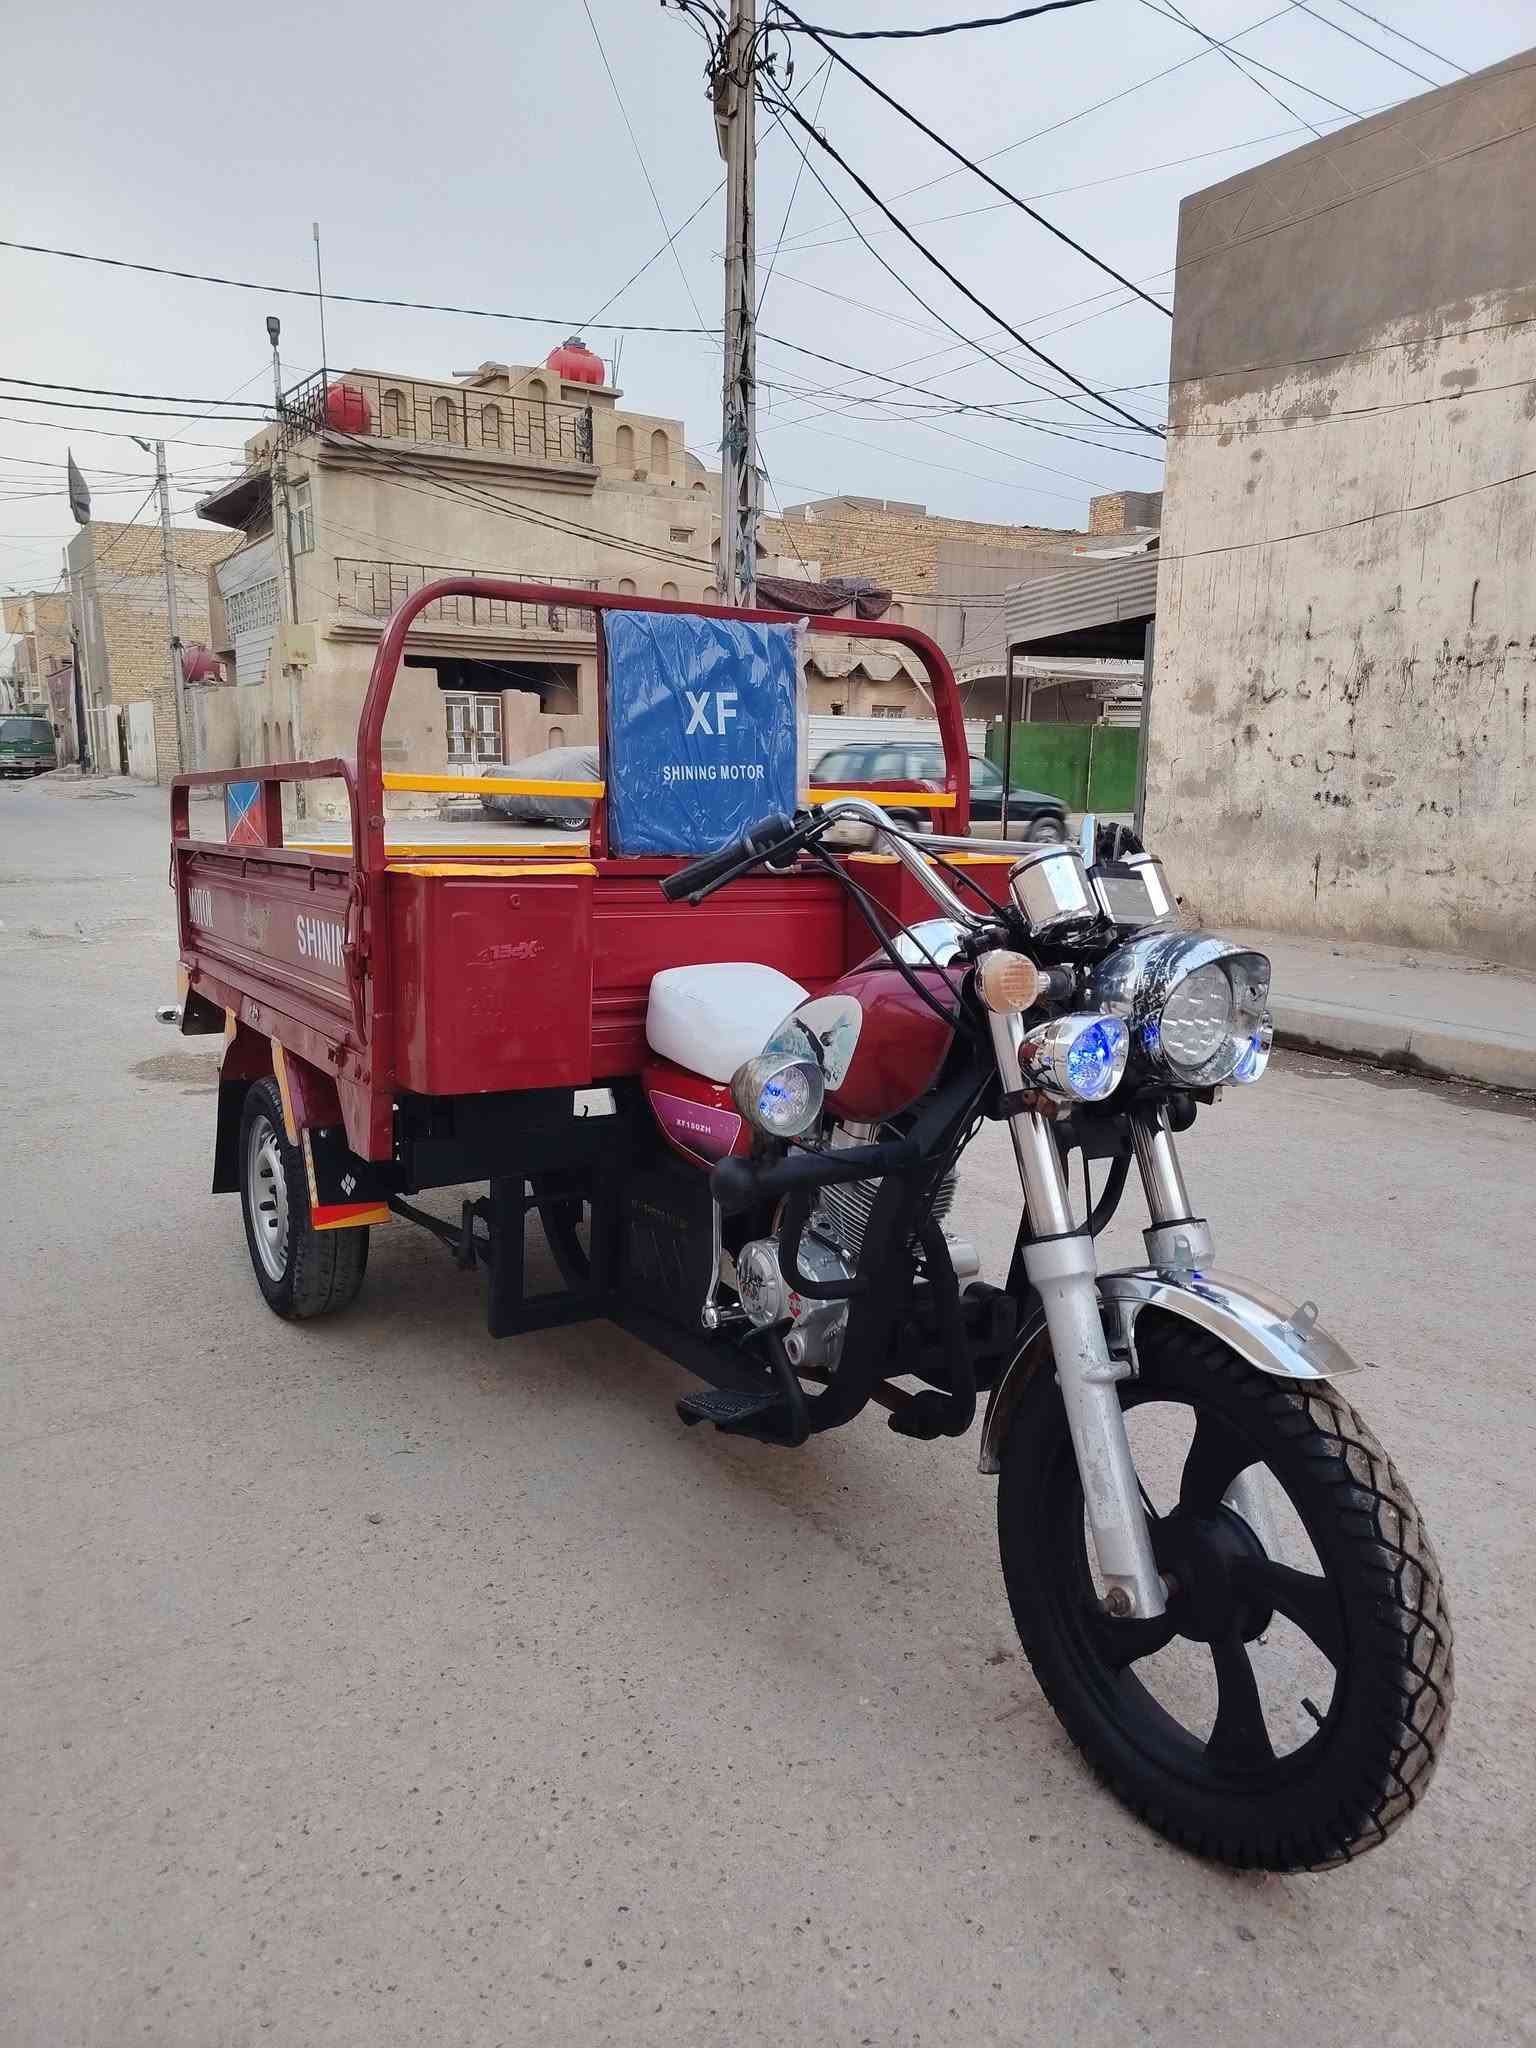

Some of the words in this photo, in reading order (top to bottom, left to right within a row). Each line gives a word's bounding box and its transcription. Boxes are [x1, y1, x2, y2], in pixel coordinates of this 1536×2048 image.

[685, 691, 738, 735] XF
[663, 765, 717, 781] SHINING
[720, 764, 765, 780] MOTOR
[297, 914, 345, 968] SHININ
